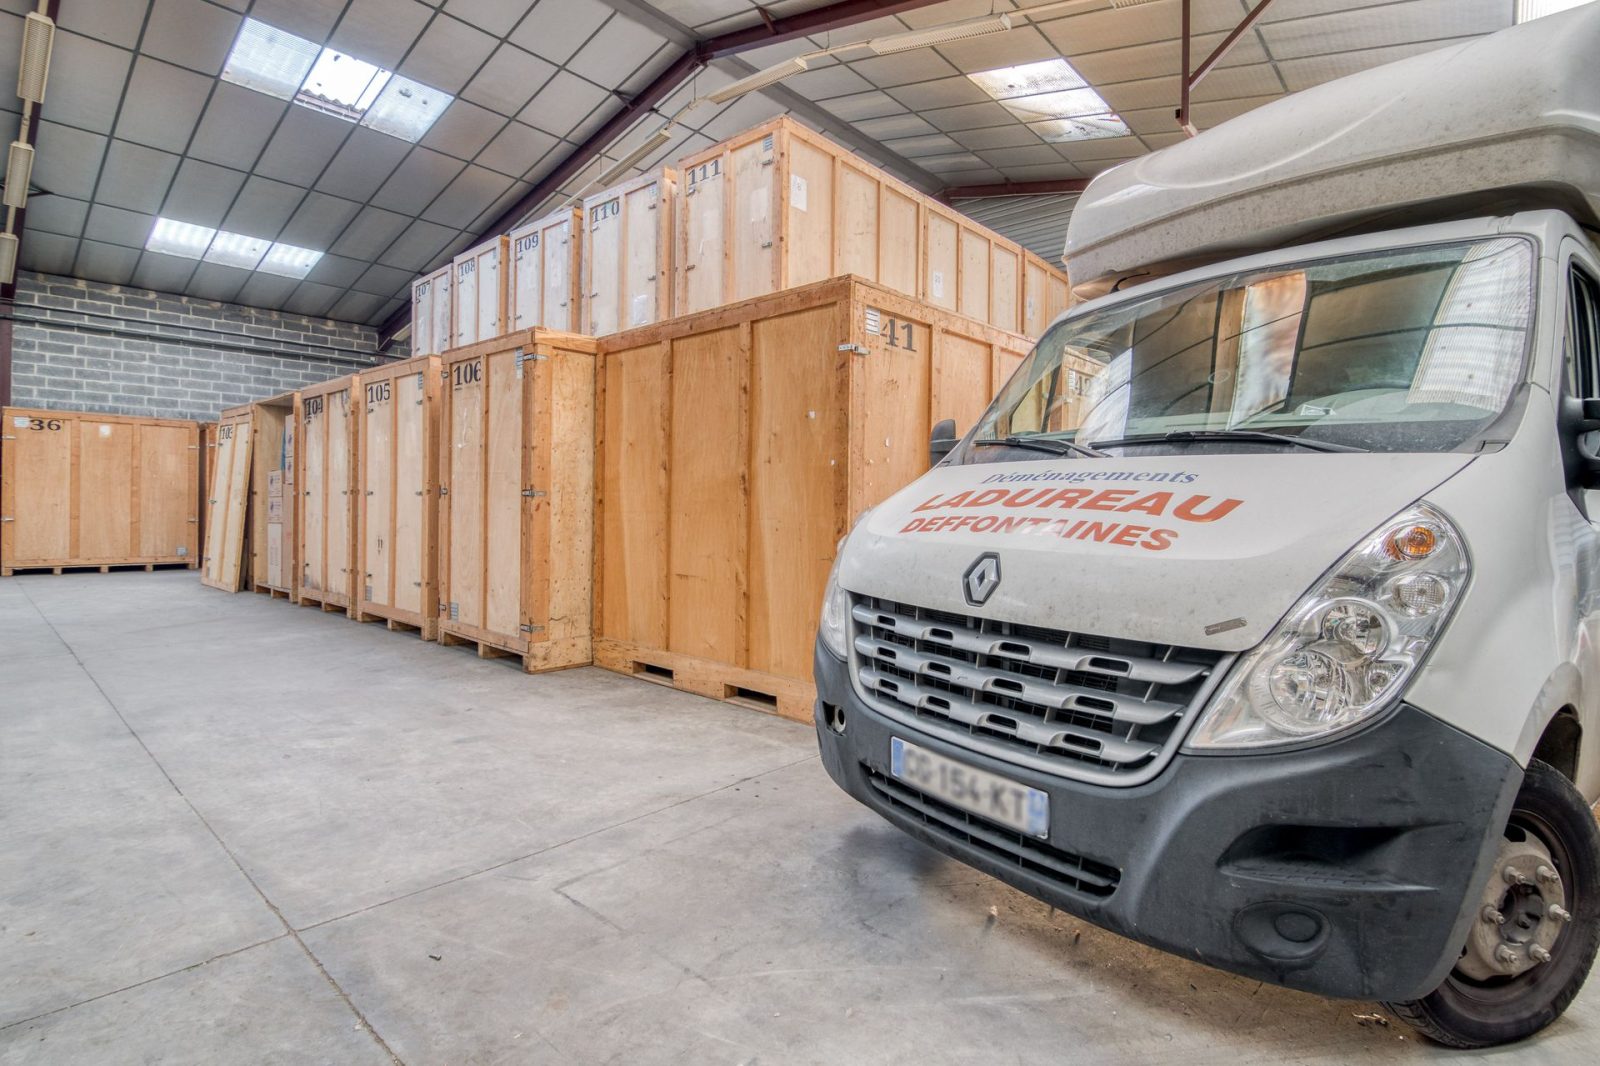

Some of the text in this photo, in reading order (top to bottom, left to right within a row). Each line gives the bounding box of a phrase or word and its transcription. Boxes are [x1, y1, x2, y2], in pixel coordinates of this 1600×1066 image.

[688, 159, 721, 185] 111
[592, 201, 620, 223] 110
[516, 234, 539, 253] 109
[460, 260, 475, 276] 108
[880, 318, 917, 352] 41
[368, 382, 391, 403] 105
[30, 419, 61, 431] 36
[980, 469, 1200, 485] Déménagements
[911, 487, 1245, 523] LADUREAU
[899, 515, 1178, 551] DEFFONTAINES
